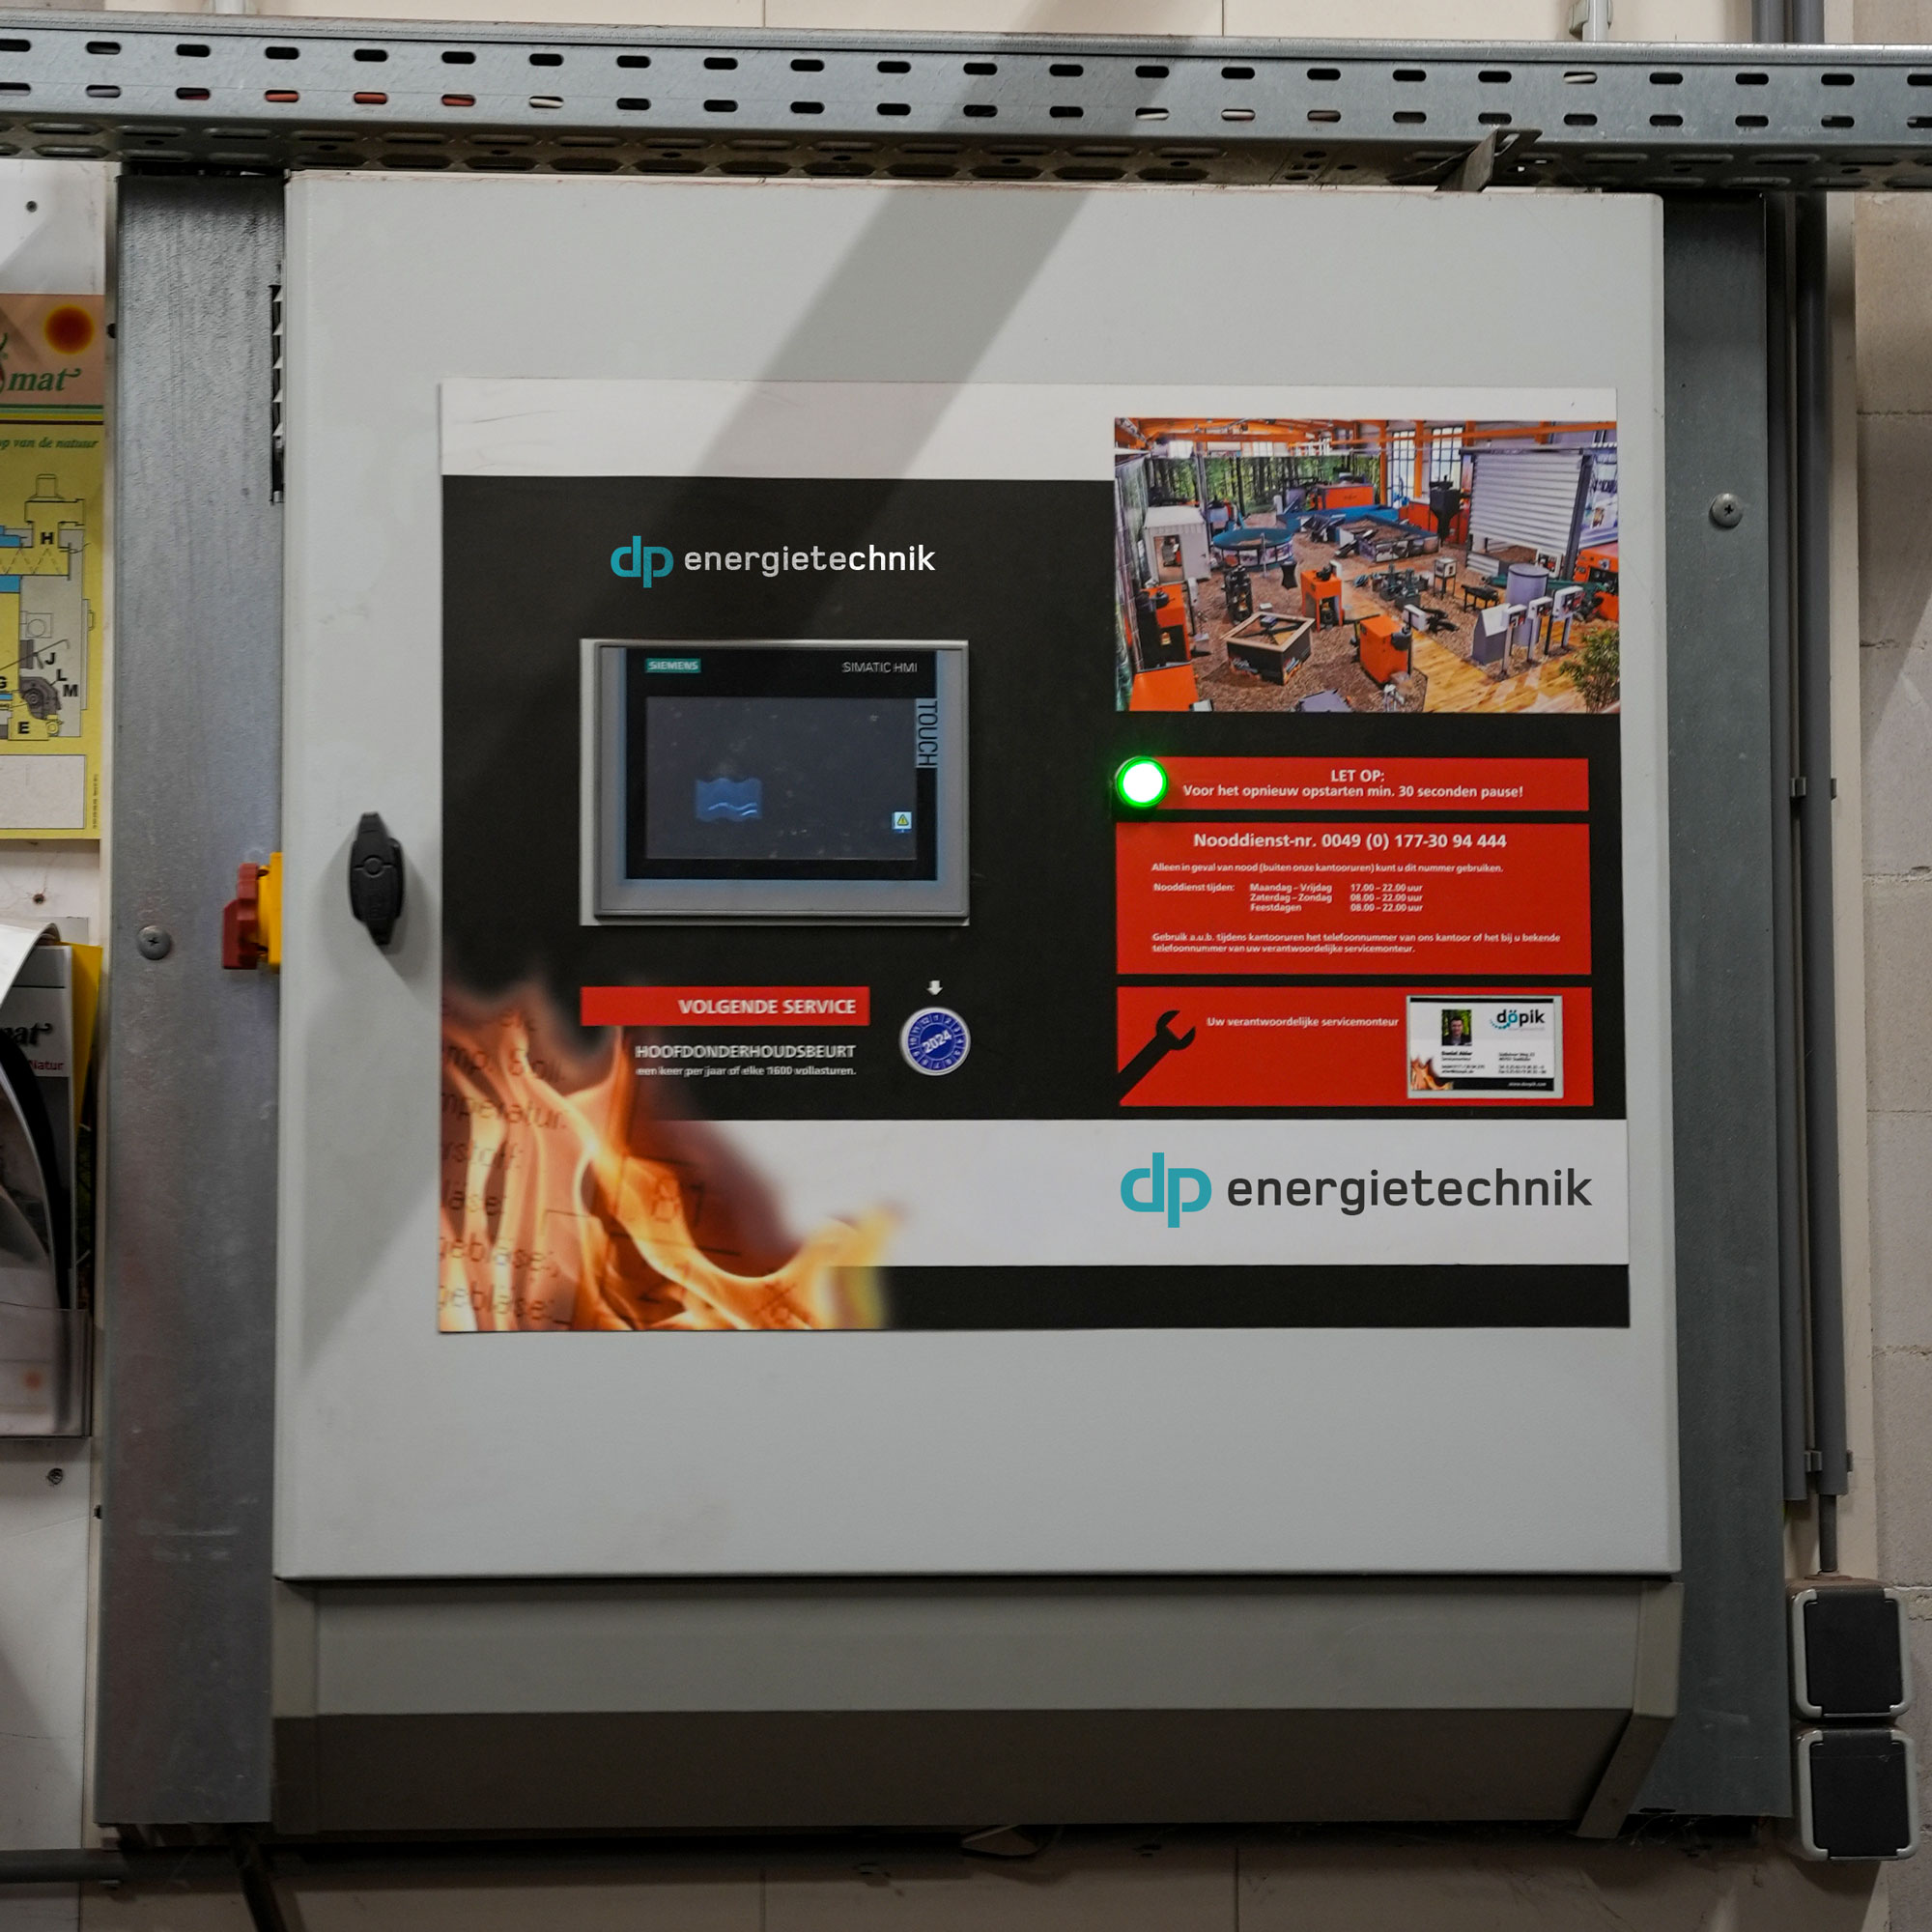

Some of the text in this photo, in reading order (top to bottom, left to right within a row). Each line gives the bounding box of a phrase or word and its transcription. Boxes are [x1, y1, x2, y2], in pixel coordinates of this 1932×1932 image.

[41, 532, 54, 544] H
[611, 536, 936, 588] dp energietechnik
[45, 652, 56, 665] J
[648, 661, 918, 673] SIEMENS SIMATIC HMI
[56, 668, 67, 681] L
[63, 684, 78, 696] M
[18, 722, 30, 734] E
[918, 701, 938, 766] TOUCH
[1331, 770, 1385, 782] LET OP:
[1183, 784, 1523, 800] Voor het opnieuw opstarten min. 30 seconden pause!
[1193, 833, 1508, 851] Nooddienst-nr. 0049 (0) 177-30 94 444
[1151, 863, 1180, 872] Alleen
[1182, 863, 1190, 872] in
[1191, 863, 1216, 874] geval
[1235, 863, 1258, 872] nood
[1260, 863, 1292, 873] (buiten
[1316, 864, 1374, 874] kantooruren)
[1376, 864, 1396, 873] kunt
[1405, 864, 1417, 873] dit
[1457, 864, 1504, 875] gebruiken.
[1153, 882, 1205, 892] Nooddienst
[1207, 882, 1236, 894] tijden:
[1250, 883, 1293, 894] Maandag
[1300, 883, 1333, 894] Vrijdag
[1350, 883, 1375, 893] 17.00
[1382, 883, 1406, 893] 22.00
[1250, 894, 1291, 903] Zaterdag
[1298, 894, 1332, 904] Zondag
[1350, 894, 1375, 902] 08.00
[1382, 894, 1406, 902] 22.00
[1250, 903, 1302, 913] Feestdagen
[1350, 903, 1375, 913] 08.00
[1382, 903, 1406, 913] 22.00
[1151, 933, 1188, 942] Gebruik
[1190, 933, 1215, 942] a.u.b.
[1217, 933, 1247, 944] tijdens
[1249, 933, 1304, 942] kantooruren
[1306, 933, 1321, 942] het
[1323, 933, 1398, 943] telefoonnummer
[1435, 933, 1471, 943] kantoor
[1473, 933, 1483, 943] of
[1484, 933, 1499, 943] het
[1501, 933, 1513, 945] bij
[1522, 933, 1561, 943] bekende
[1151, 944, 1227, 953] telefoonnummer
[1263, 944, 1343, 954] verantwoordelijke
[1345, 944, 1416, 954] servicemonteur.
[678, 999, 857, 1014] VOLGENDE SERVICE
[1207, 1017, 1400, 1028] Uw verantwoordelijke servicemonteur
[1496, 1009, 1546, 1027] döpik
[922, 1029, 952, 1054] 2024
[635, 1044, 857, 1060] HOOFDONDERHOUDSBEURT
[636, 1065, 857, 1078] een keer per jaar of elke 1600 vollasturen.
[1120, 1152, 1593, 1229] dp energietechnik
